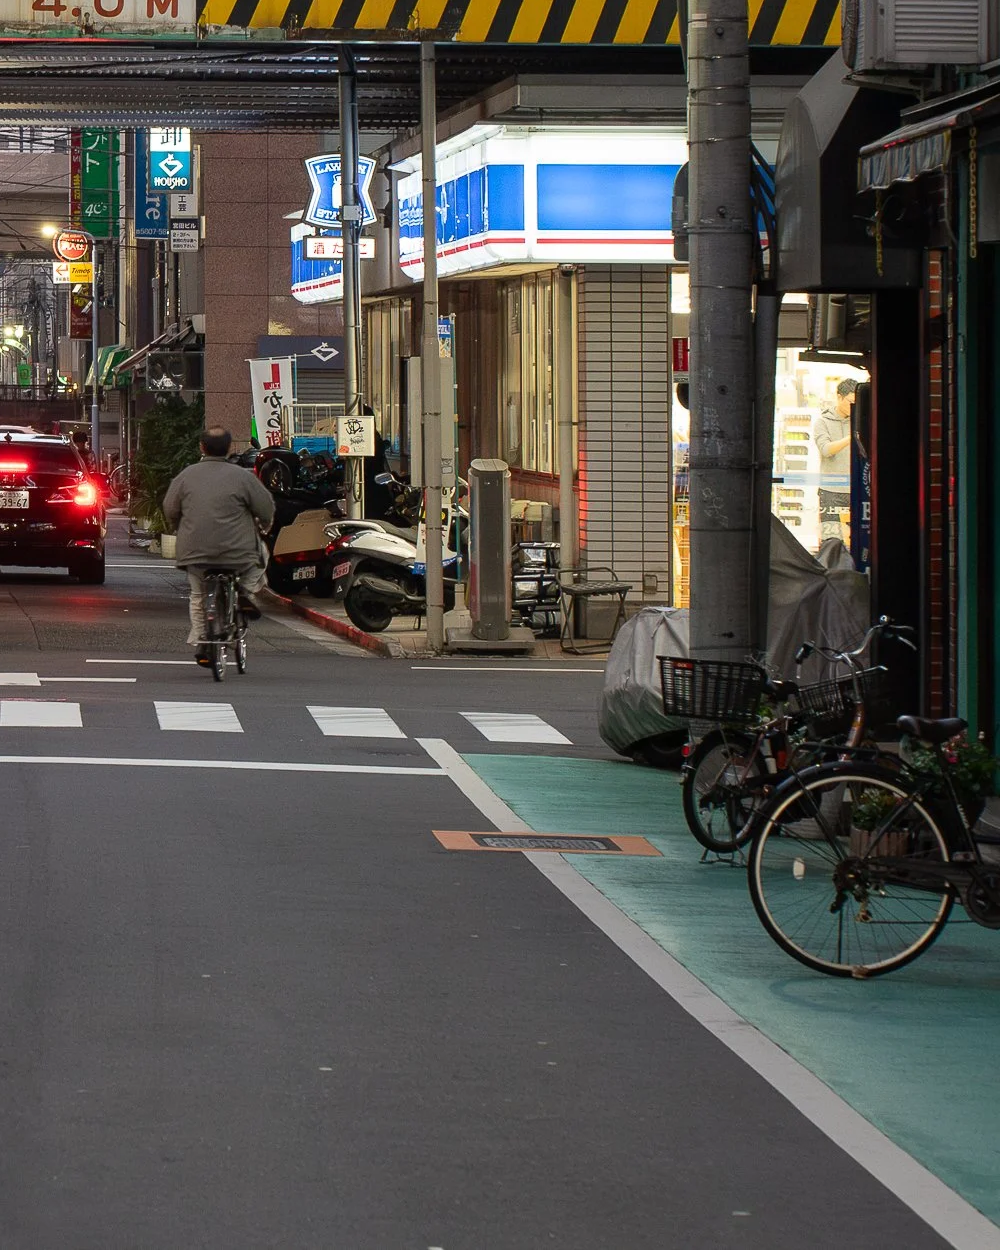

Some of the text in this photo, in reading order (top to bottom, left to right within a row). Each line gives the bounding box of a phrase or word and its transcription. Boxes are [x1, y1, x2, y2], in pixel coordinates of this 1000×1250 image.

[315, 162, 367, 175] LAWN
[154, 177, 188, 189] HOUSHO
[333, 242, 368, 255] たこ
[2, 498, 27, 507] 39-67
